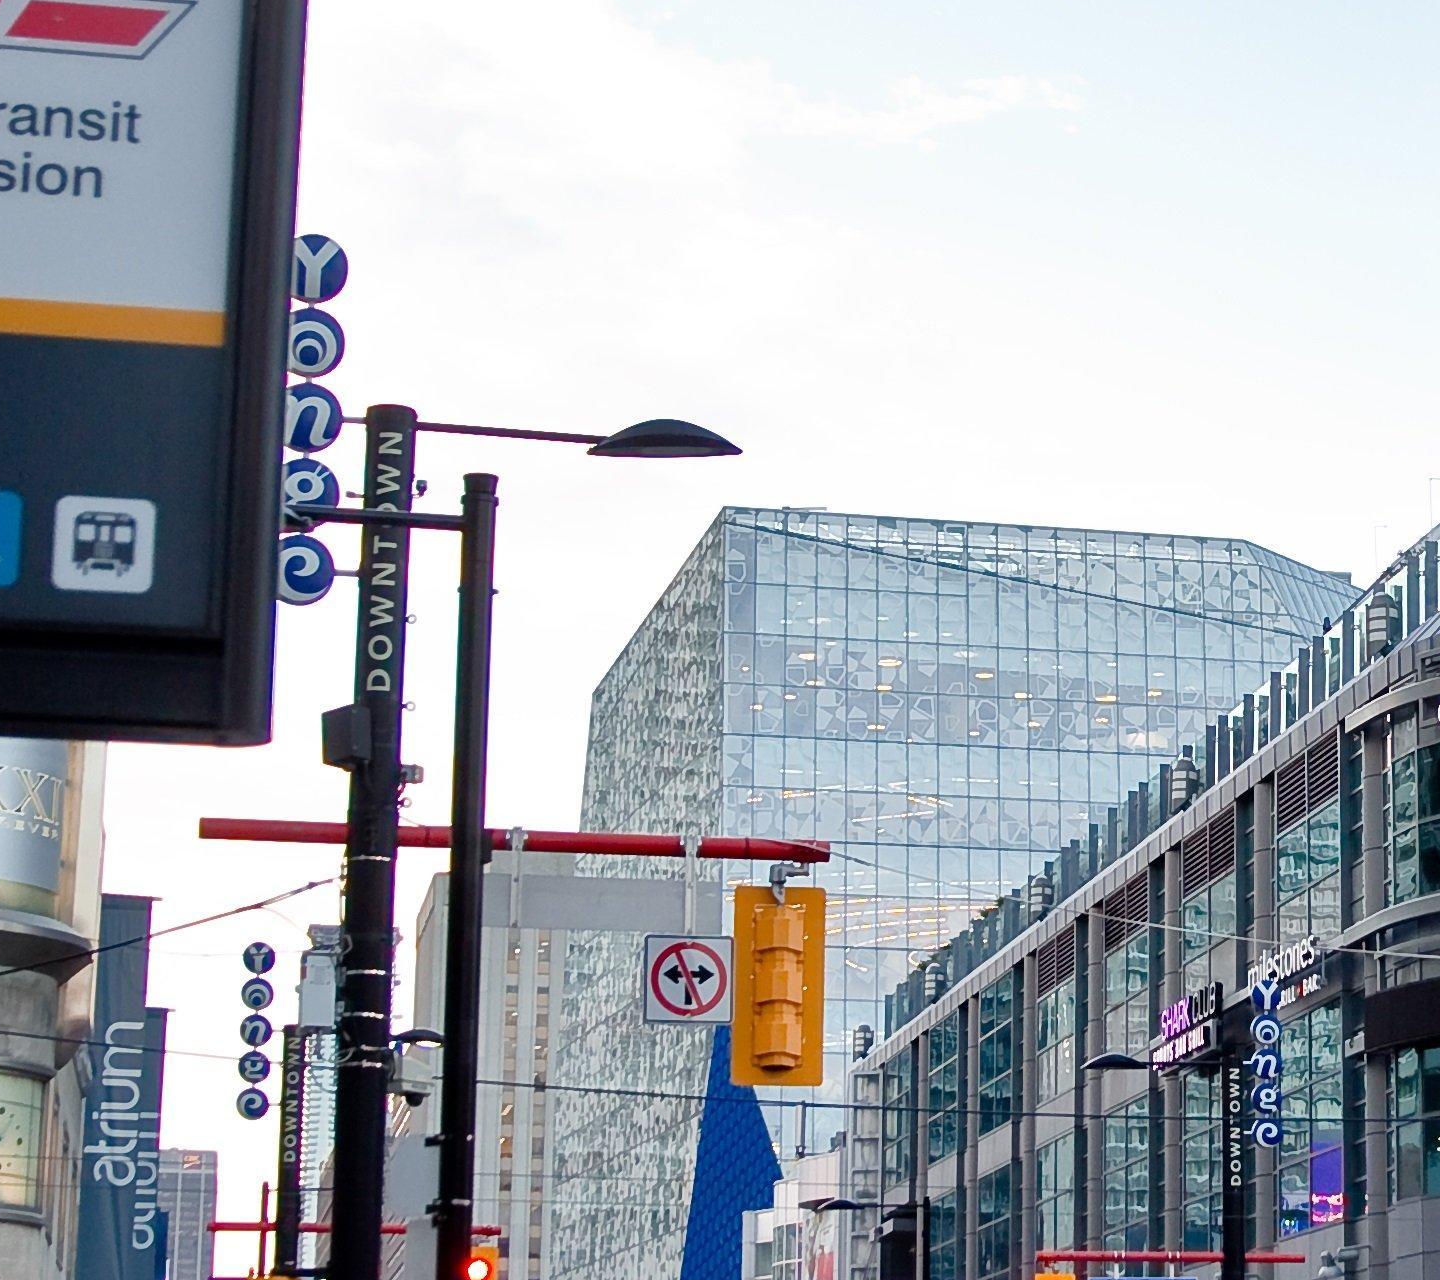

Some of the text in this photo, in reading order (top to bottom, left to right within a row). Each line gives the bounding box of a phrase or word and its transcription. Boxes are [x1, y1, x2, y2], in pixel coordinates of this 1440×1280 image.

[1161, 996, 1190, 1041] SHARK
[1253, 981, 1281, 1147] Yonge
[85, 1022, 144, 1186] atrium
[284, 1037, 301, 1162] DOWNTOWN
